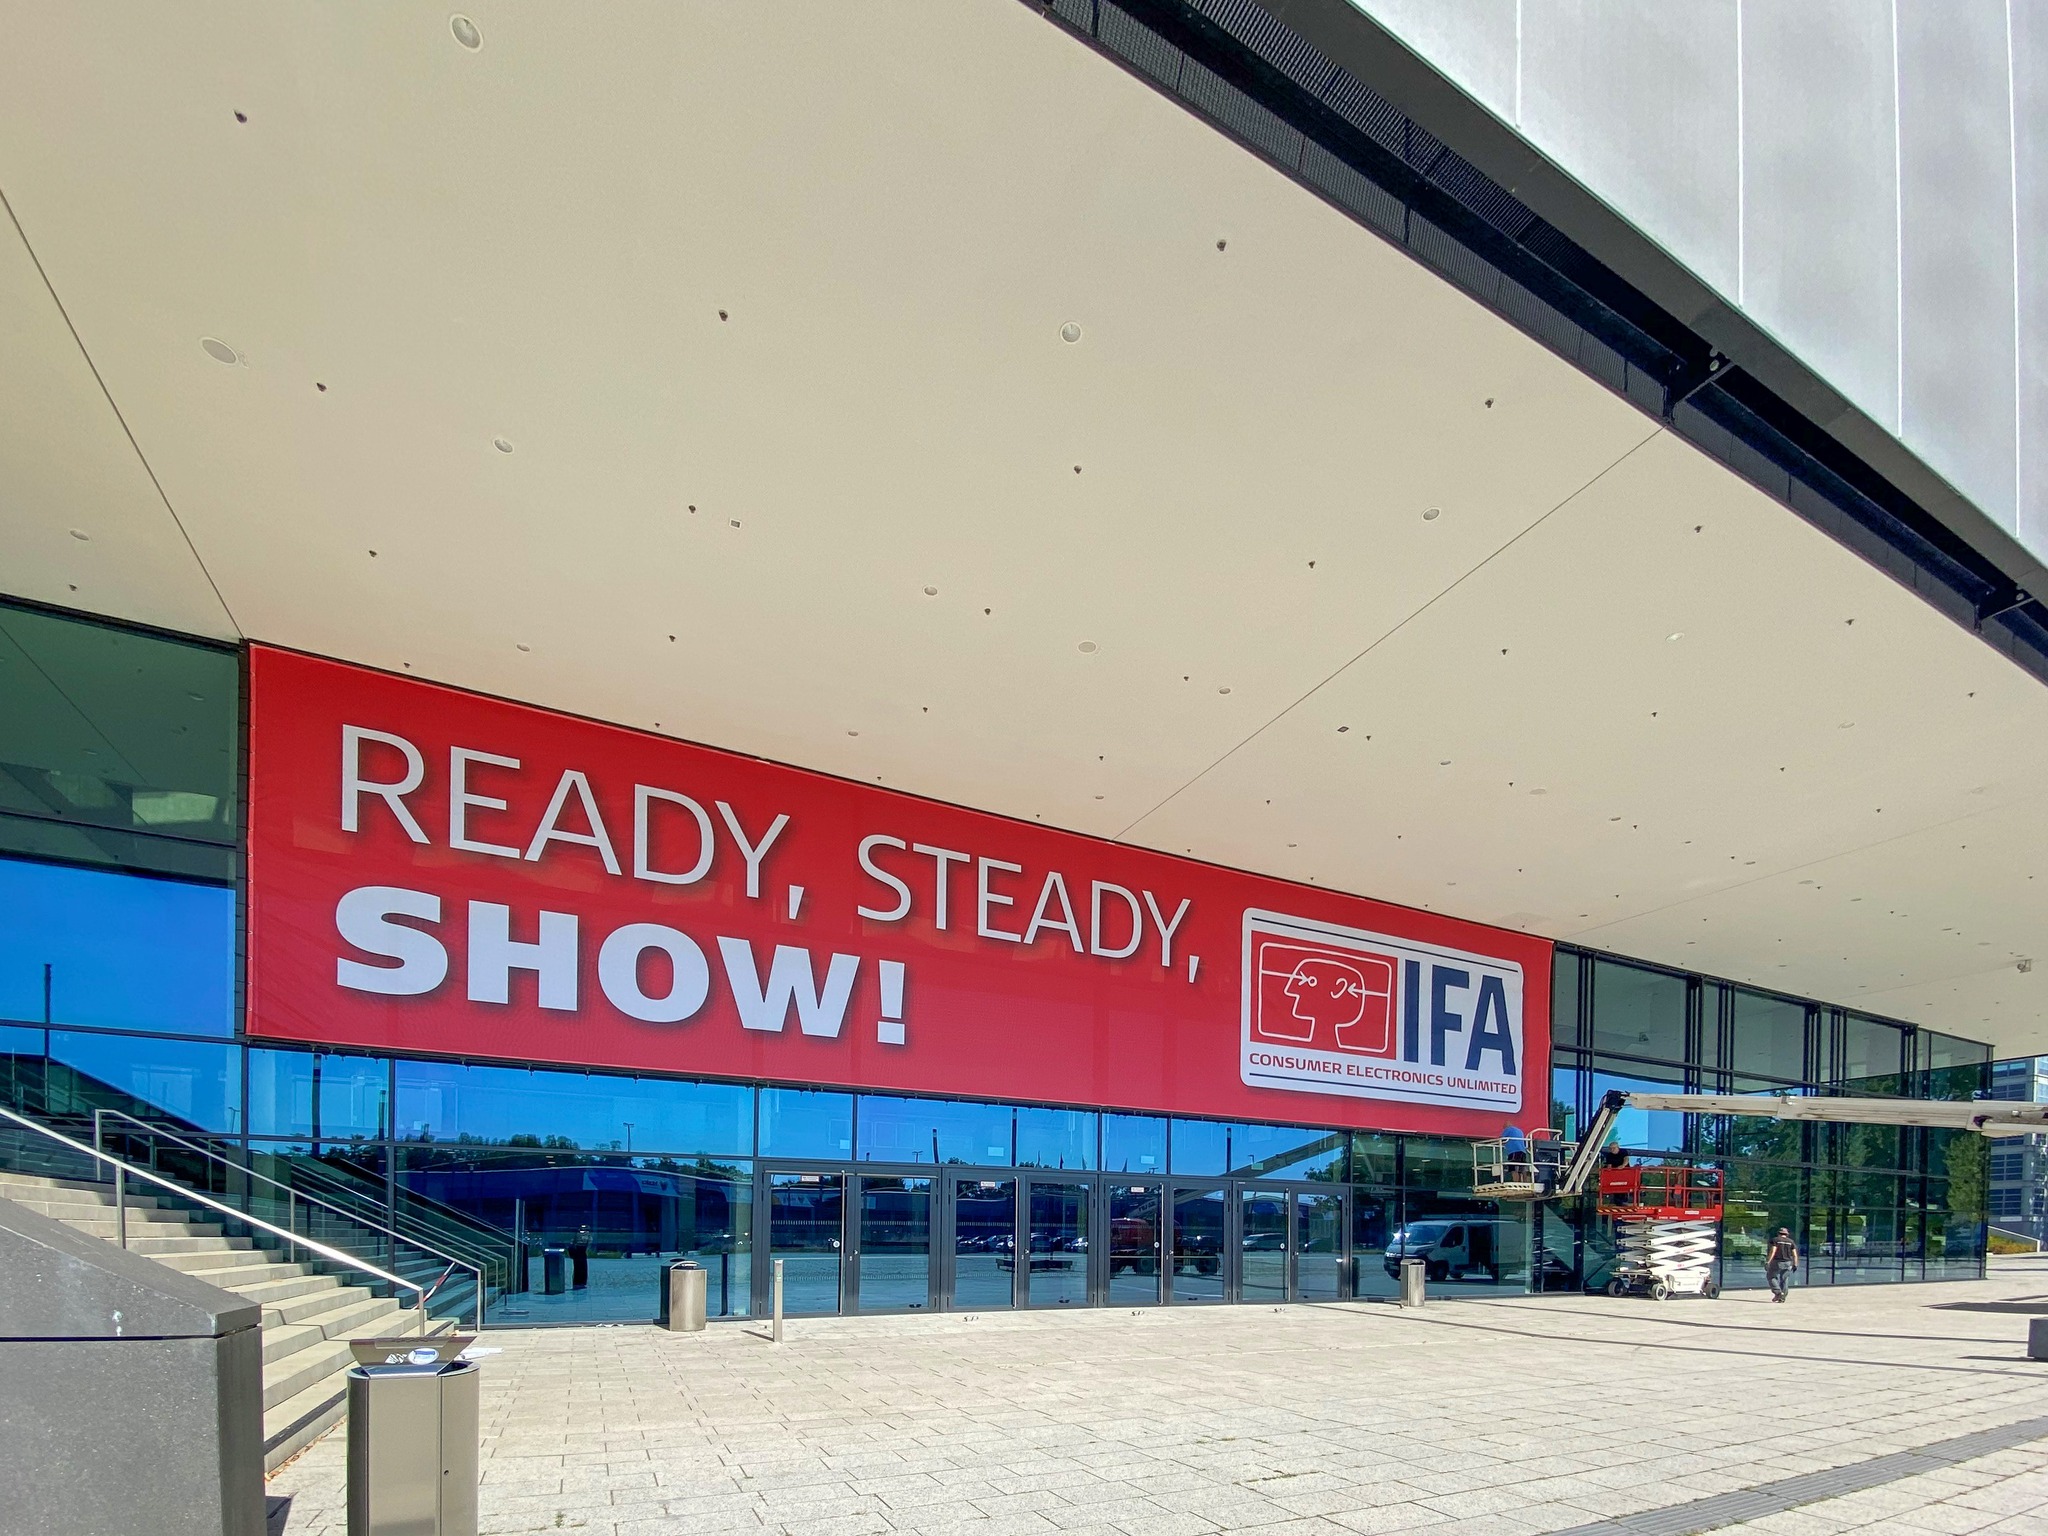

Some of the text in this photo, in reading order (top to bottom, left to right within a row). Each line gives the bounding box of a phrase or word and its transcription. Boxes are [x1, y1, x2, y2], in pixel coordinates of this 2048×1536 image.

[340, 724, 1199, 983] READY, STEADY,
[336, 886, 905, 1045] SHOW!
[1404, 959, 1516, 1075] IFA
[1249, 1053, 1517, 1095] CONSUMER ELECTRONICS UNLIMITED
